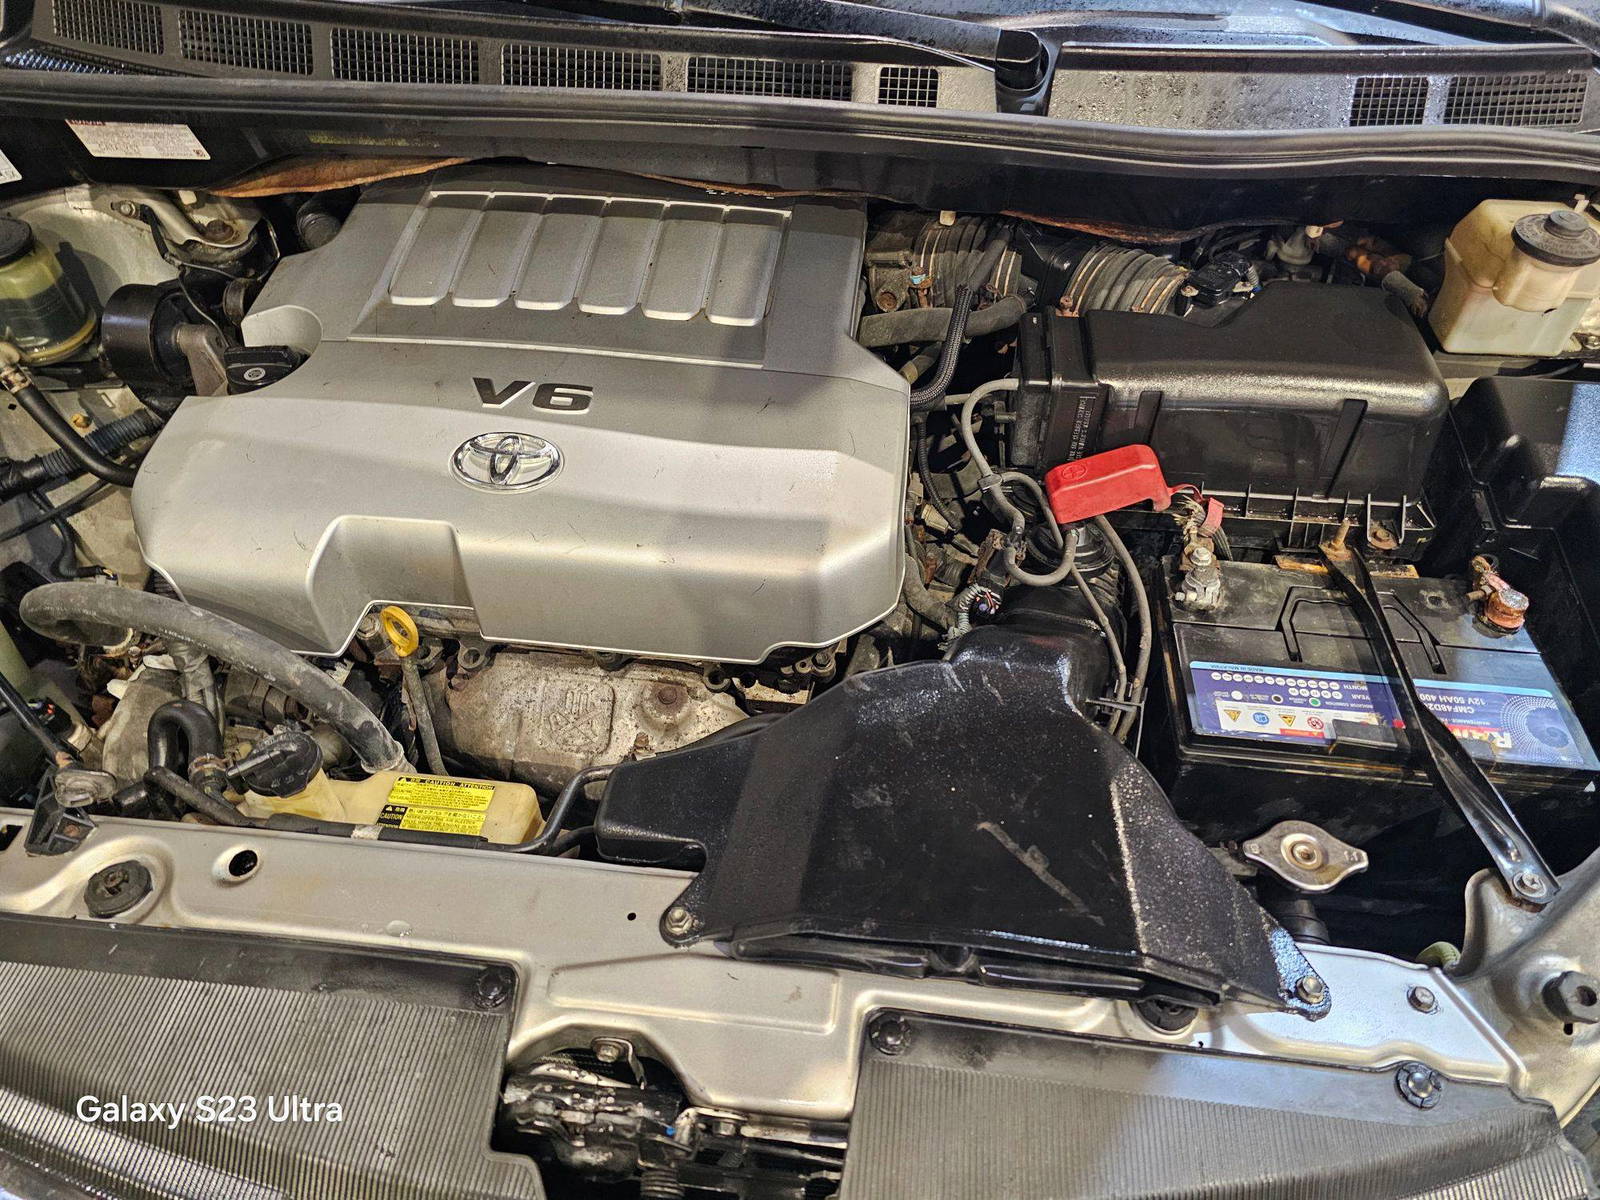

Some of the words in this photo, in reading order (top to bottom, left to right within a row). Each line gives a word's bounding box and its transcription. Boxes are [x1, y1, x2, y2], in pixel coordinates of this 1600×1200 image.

[472, 377, 593, 415] V6
[1351, 693, 1371, 701] YEAR
[1438, 695, 1465, 704] 50AH
[1468, 697, 1487, 706] 12V
